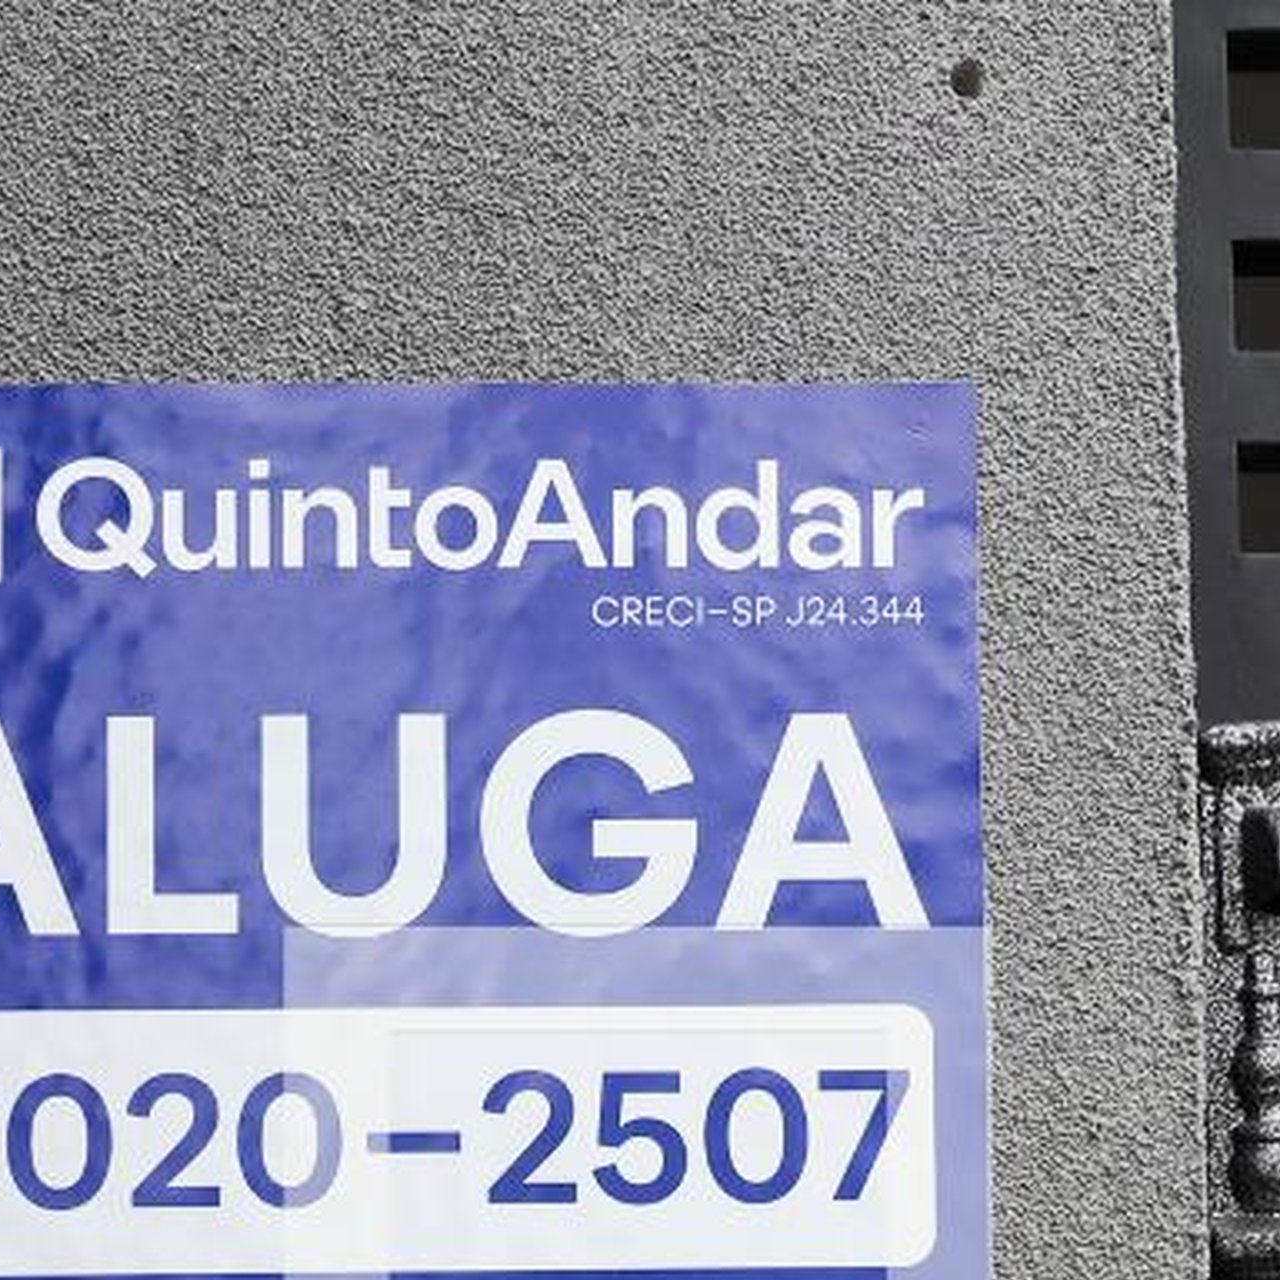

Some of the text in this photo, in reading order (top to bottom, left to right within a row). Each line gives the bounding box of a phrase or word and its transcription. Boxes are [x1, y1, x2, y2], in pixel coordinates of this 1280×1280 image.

[36, 455, 925, 579] QuintoAndar
[592, 595, 925, 628] CRECI-SP J24.344
